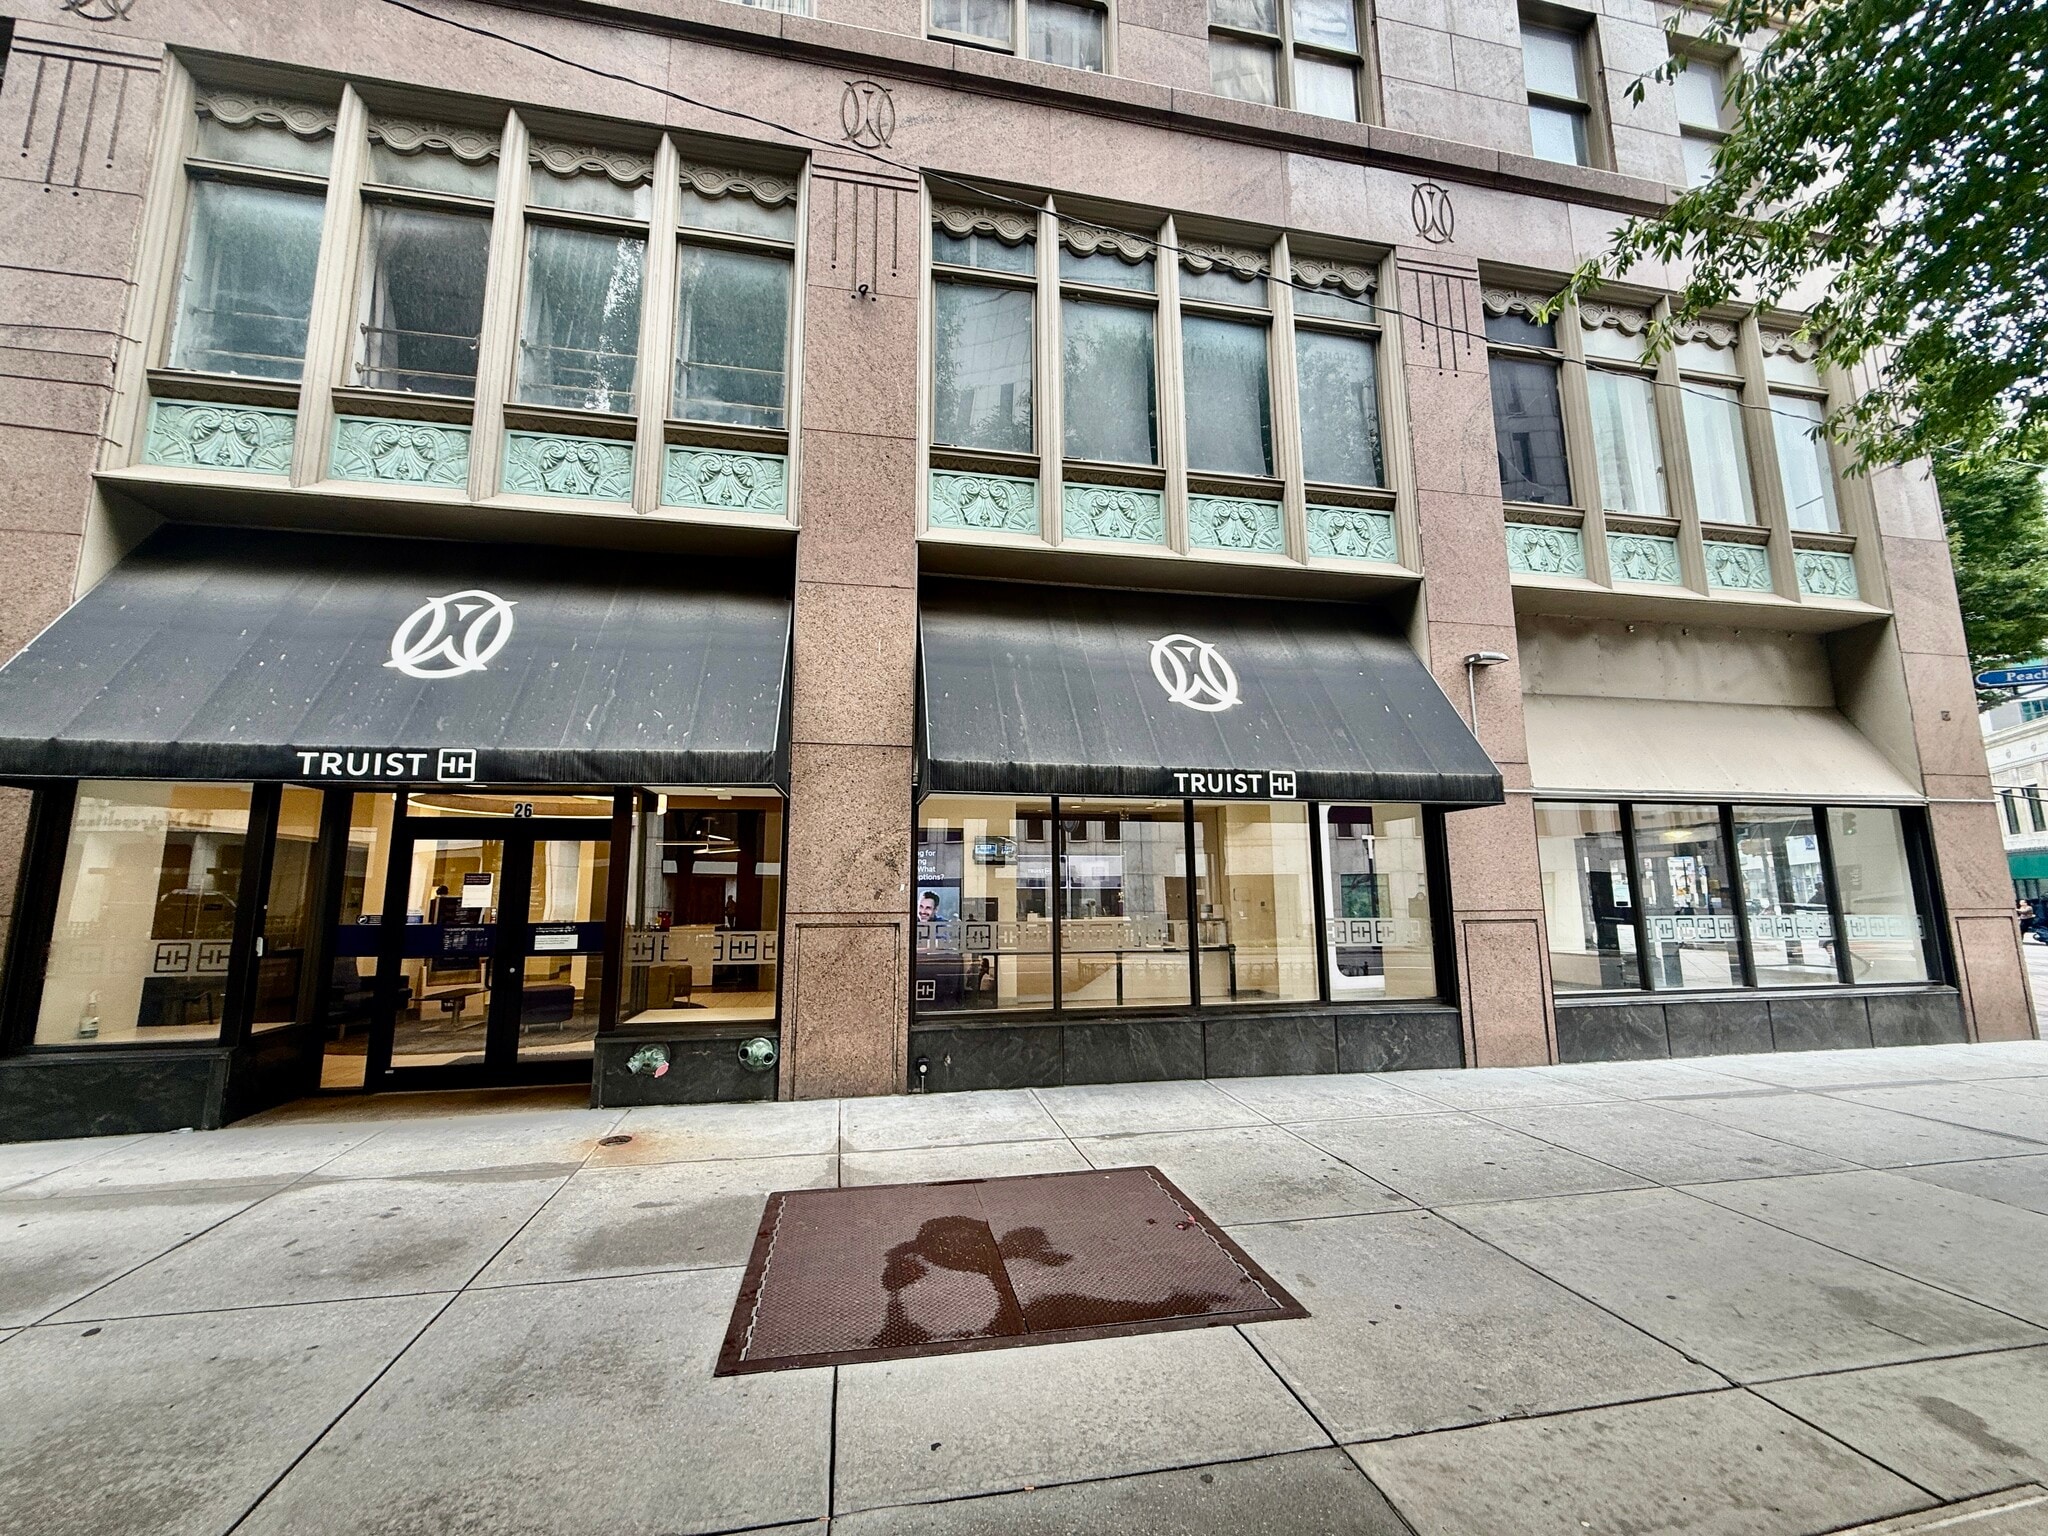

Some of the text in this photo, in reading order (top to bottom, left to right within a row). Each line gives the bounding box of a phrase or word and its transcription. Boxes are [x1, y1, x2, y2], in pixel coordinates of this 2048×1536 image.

[297, 751, 427, 776] TRUIST
[1173, 772, 1262, 793] TRUIST
[514, 803, 533, 818] 26
[918, 873, 945, 881] ptions?
